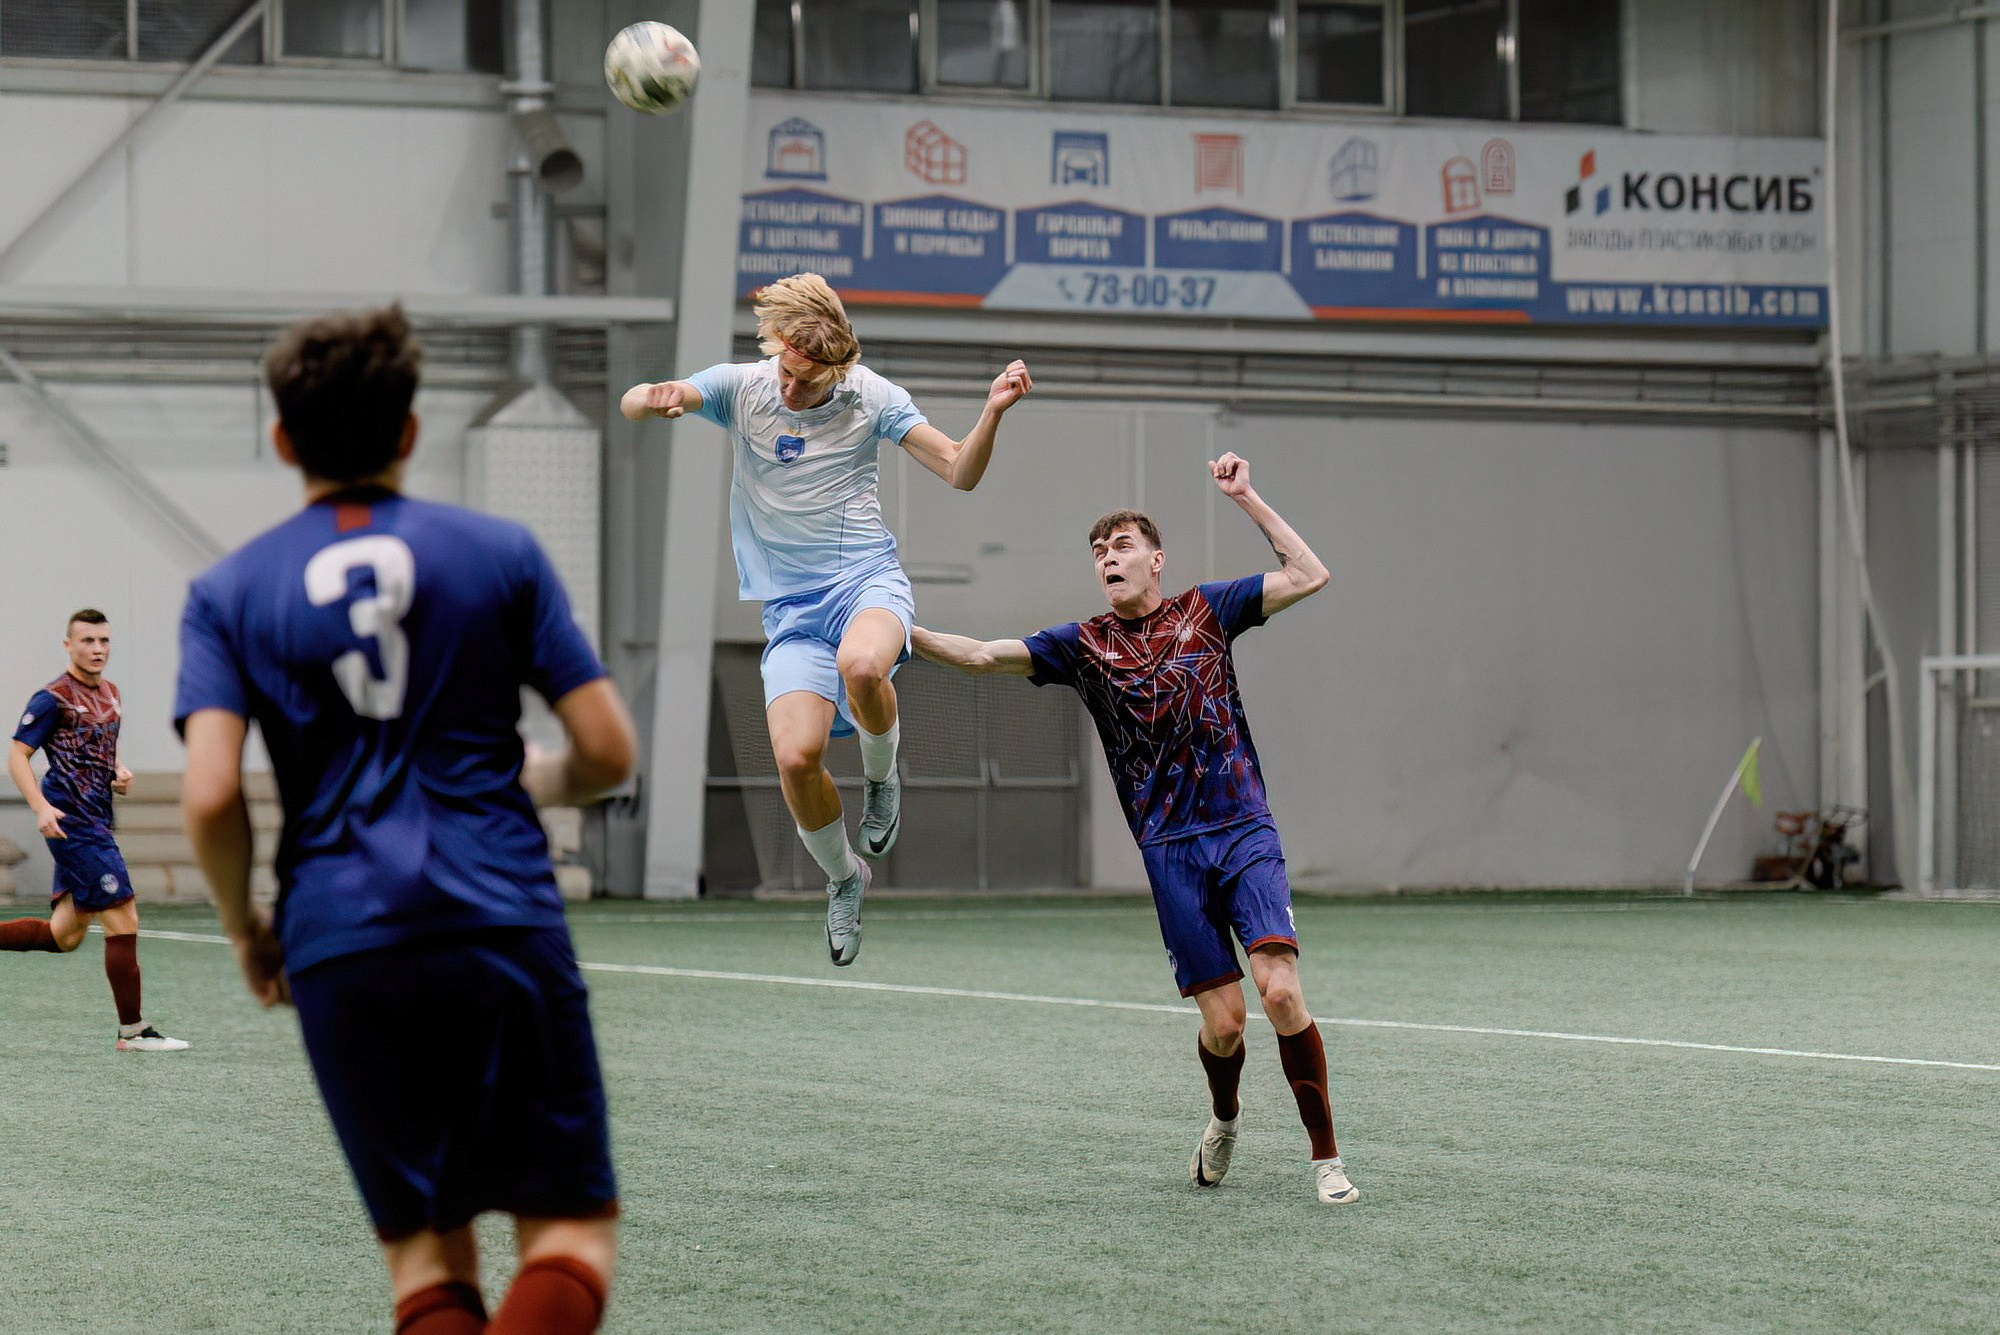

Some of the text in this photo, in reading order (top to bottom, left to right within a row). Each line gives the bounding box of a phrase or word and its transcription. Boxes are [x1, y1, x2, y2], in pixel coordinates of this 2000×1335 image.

[1624, 172, 1814, 213] КОНСИБ
[1083, 272, 1216, 308] 73-00-37
[1565, 284, 1820, 317] www.konsib.com
[304, 535, 415, 721] 3
